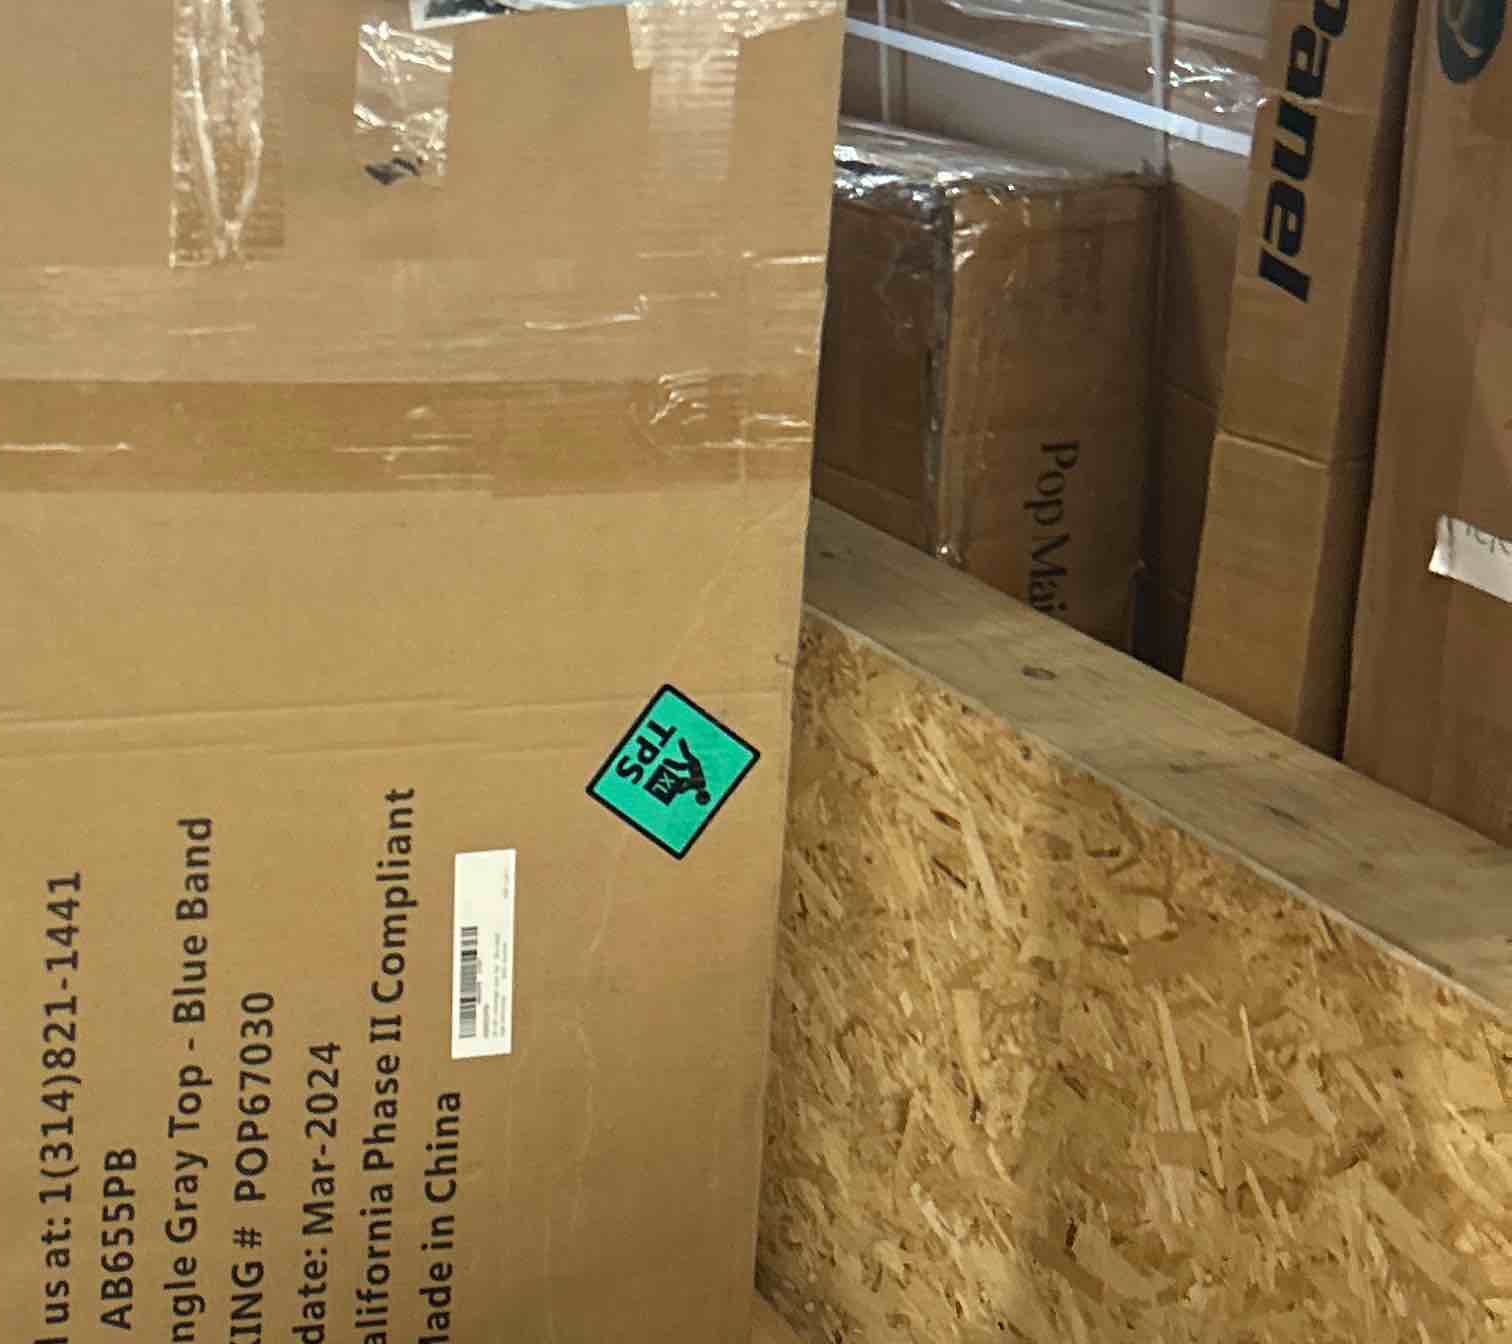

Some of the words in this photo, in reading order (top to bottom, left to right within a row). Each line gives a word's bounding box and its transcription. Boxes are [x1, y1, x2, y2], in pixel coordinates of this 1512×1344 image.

[1023, 440, 1079, 526] Pop
[615, 719, 678, 785] TPS
[175, 818, 213, 921] Band
[370, 788, 419, 1004] Compliant
[171, 935, 208, 1024] Blue
[38, 871, 82, 1205] 1(314)821-1441
[369, 1014, 403, 1044] II
[167, 1064, 213, 1139] Top
[233, 992, 275, 1203] POP67030
[301, 1041, 342, 1237] Mar-2024
[361, 1054, 401, 1172] Phase
[423, 1092, 461, 1204] China
[40, 1216, 72, 1268] at:
[99, 1148, 137, 1331] AB655PB
[164, 1150, 209, 1244] Gray
[232, 1226, 263, 1249] #
[420, 1215, 456, 1252] in
[43, 1278, 71, 1321] us
